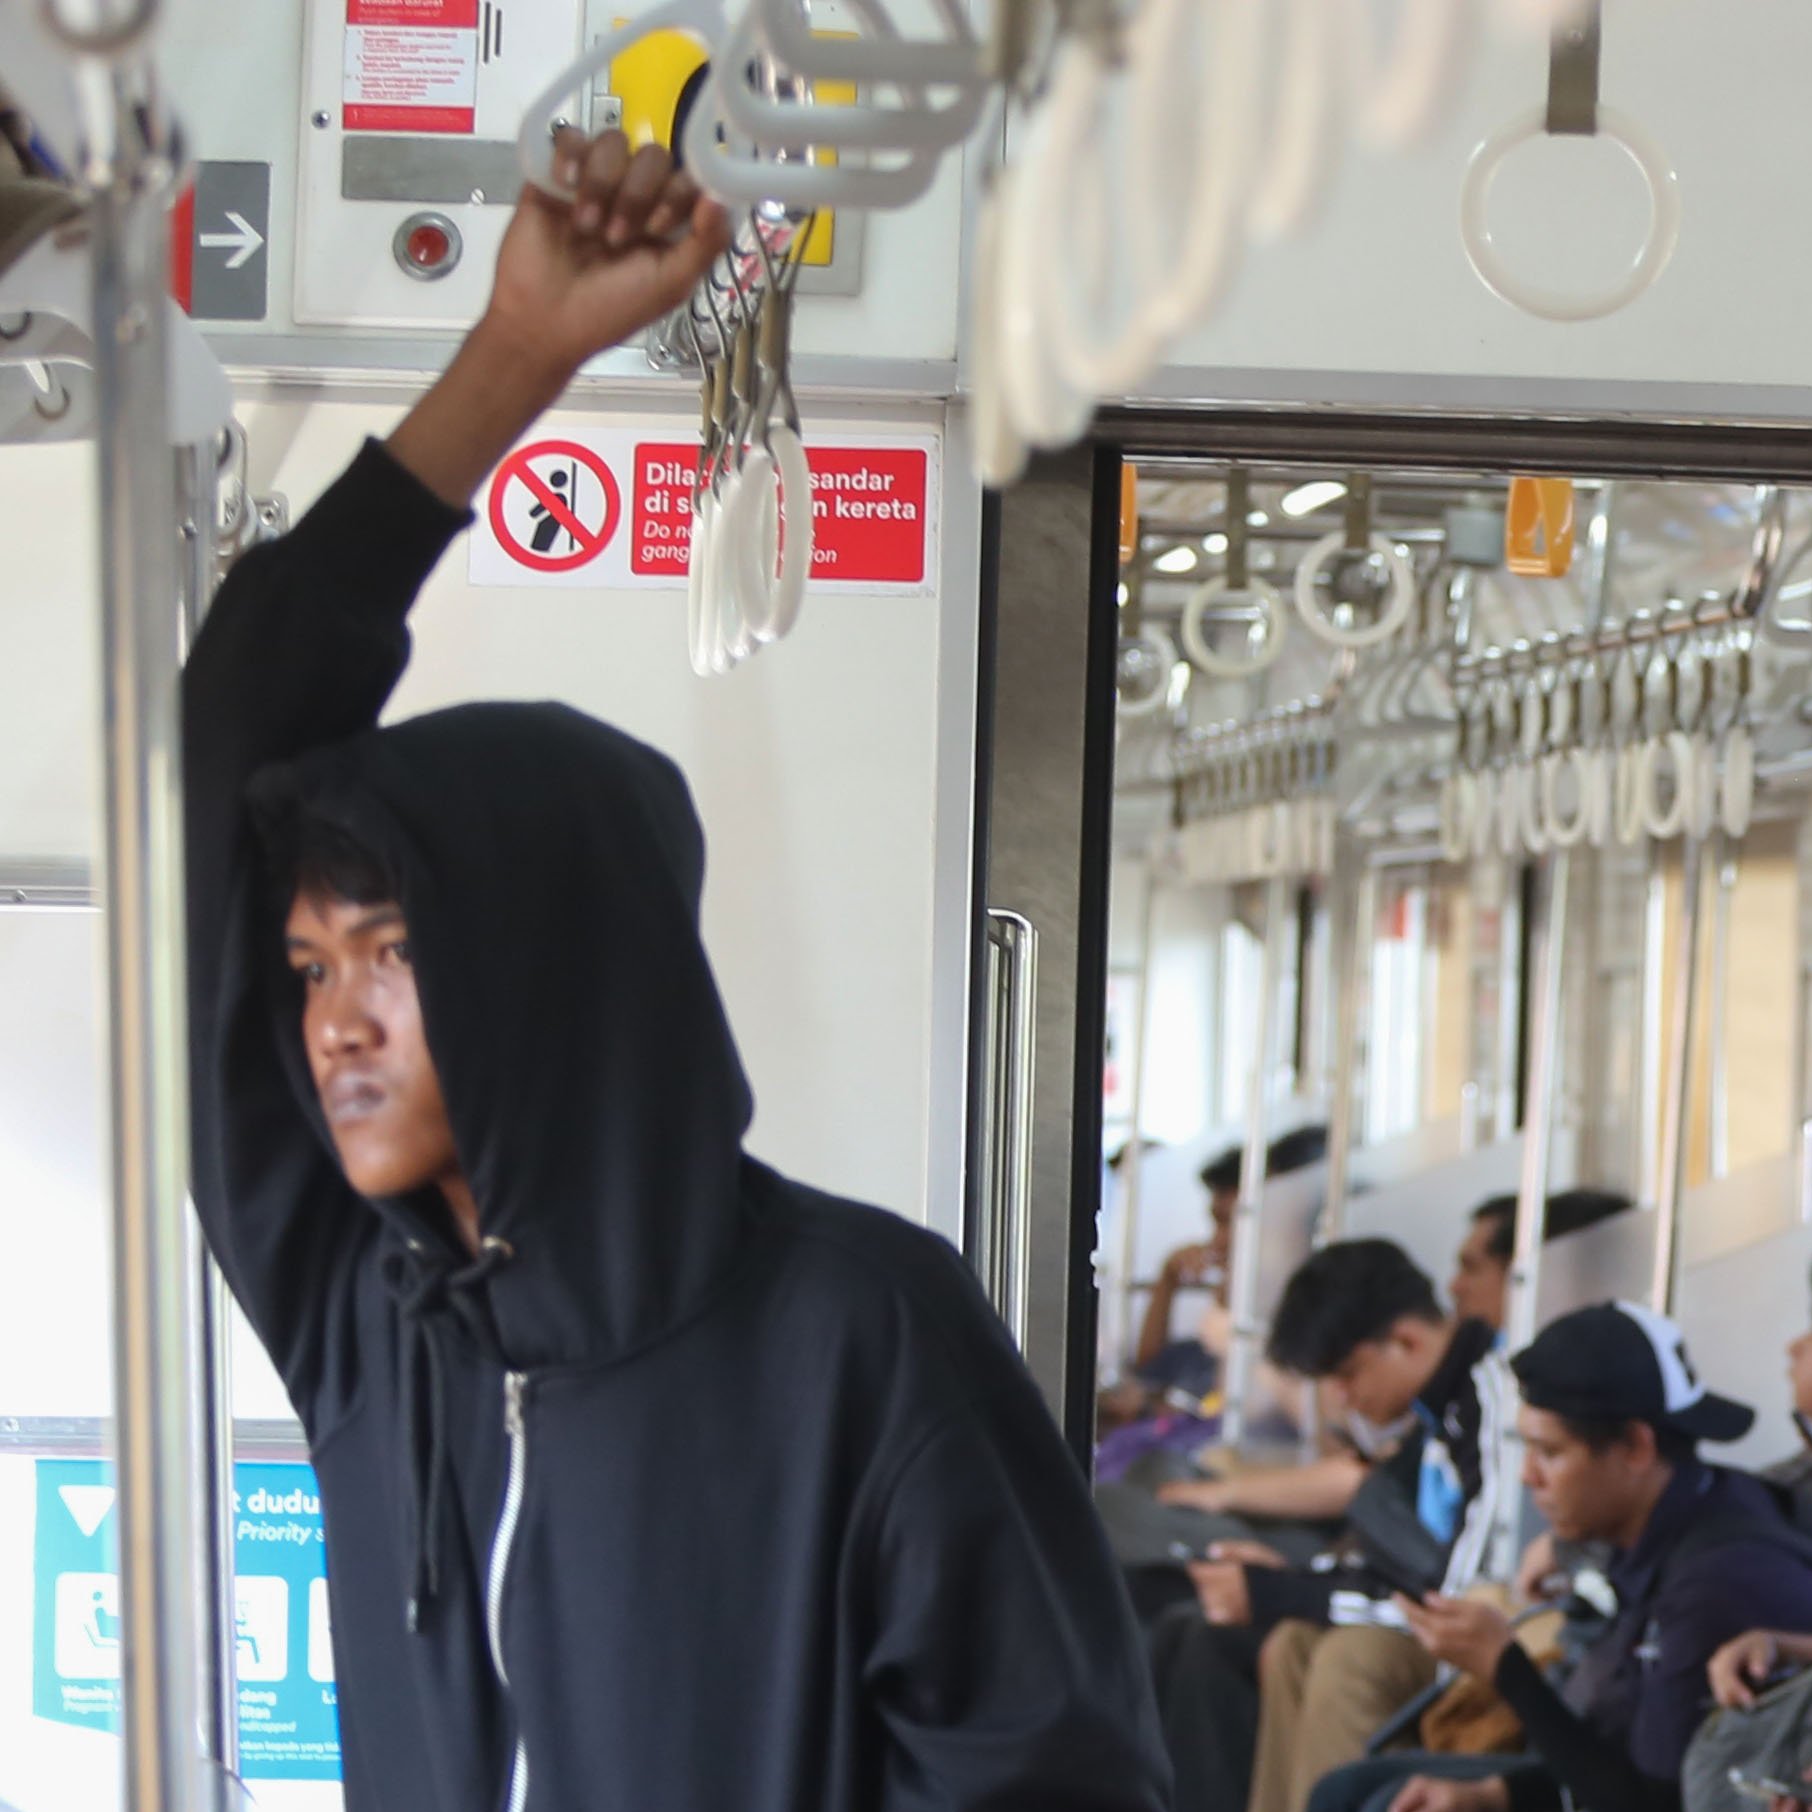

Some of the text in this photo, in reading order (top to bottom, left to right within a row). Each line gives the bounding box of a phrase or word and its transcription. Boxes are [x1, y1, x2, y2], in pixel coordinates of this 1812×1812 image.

[645, 493, 671, 513] di
[835, 496, 917, 520] kereta
[643, 521, 670, 539] Do
[248, 1488, 321, 1514] dudu
[237, 1520, 313, 1546] Priority
